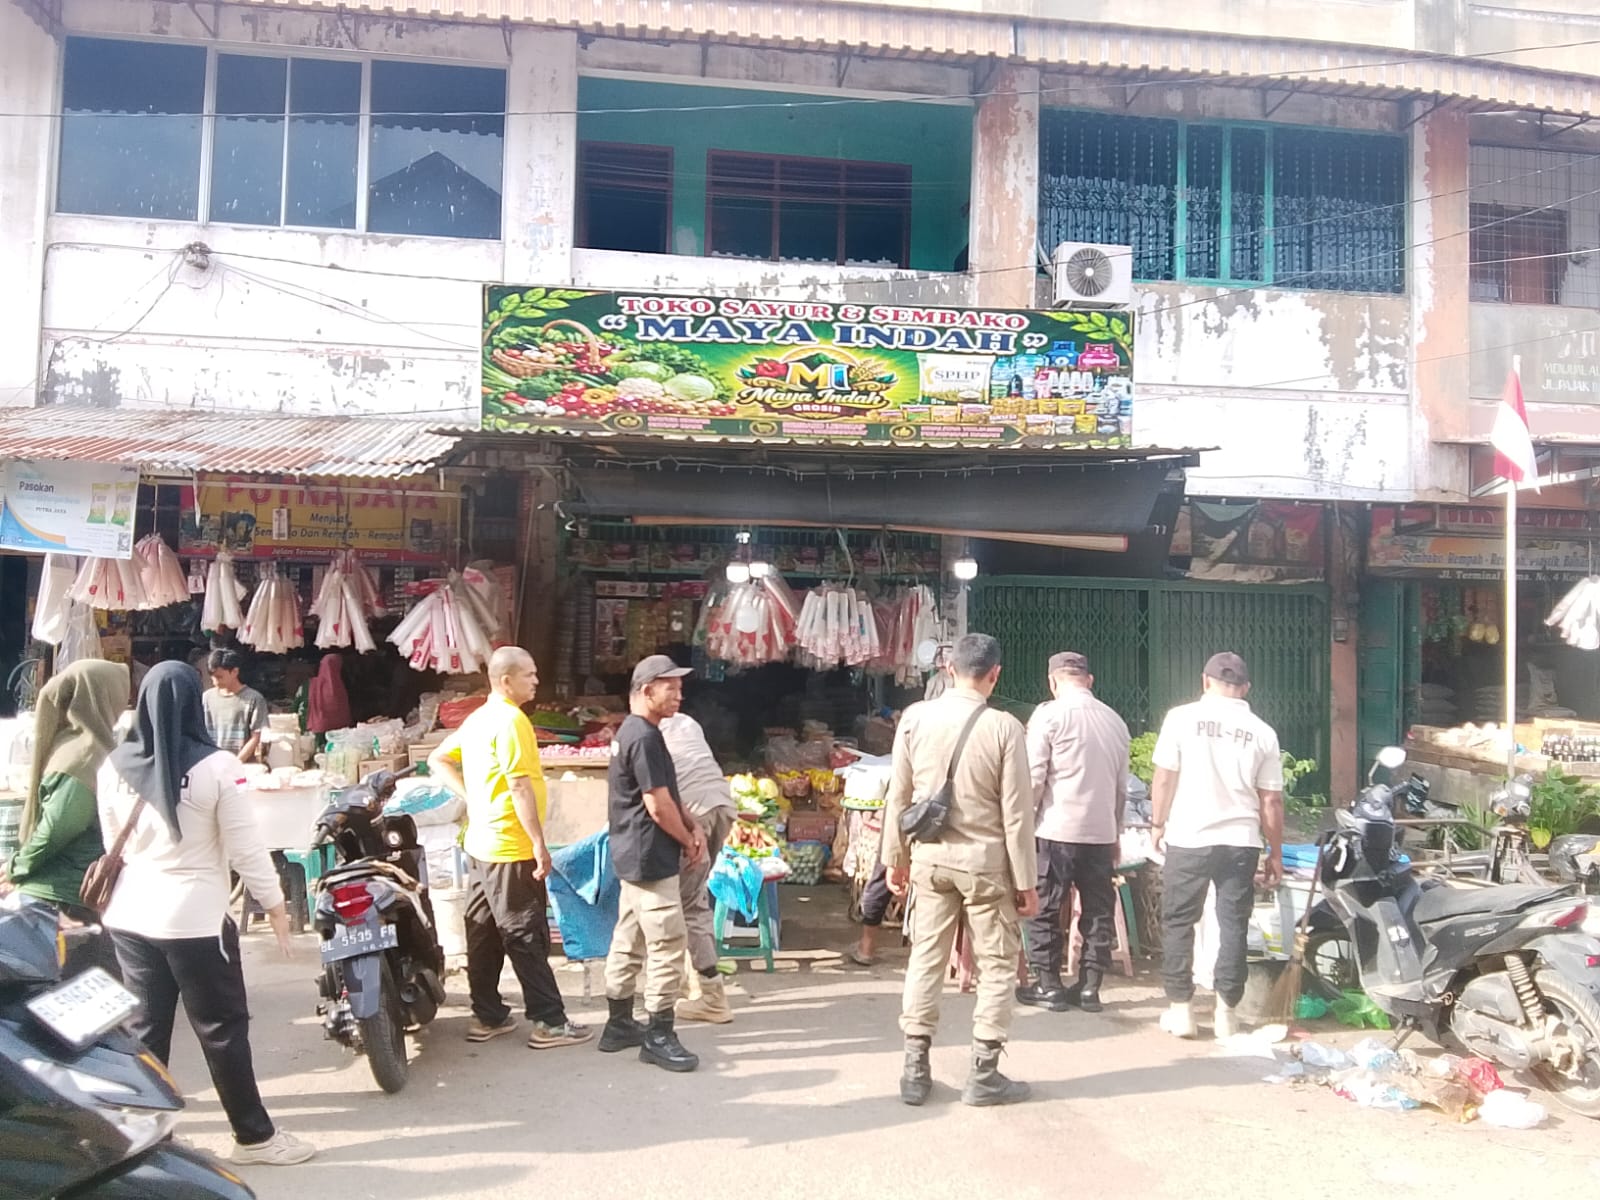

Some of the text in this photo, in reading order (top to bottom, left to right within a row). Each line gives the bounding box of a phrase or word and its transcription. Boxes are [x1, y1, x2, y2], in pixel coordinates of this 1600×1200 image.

[619, 298, 1027, 329] TOKO SAYUR & SEMBAKO
[935, 370, 981, 380] SPHP
[739, 388, 886, 407] Maya Indah
[792, 404, 842, 413] GROSIR
[18, 481, 55, 493] Pasokan
[354, 479, 439, 510] JAYA
[1455, 570, 1501, 580] Terminal
[1196, 720, 1254, 749] POL-PP
[320, 940, 336, 953] BL
[341, 930, 373, 947] 5535
[380, 924, 396, 938] FR
